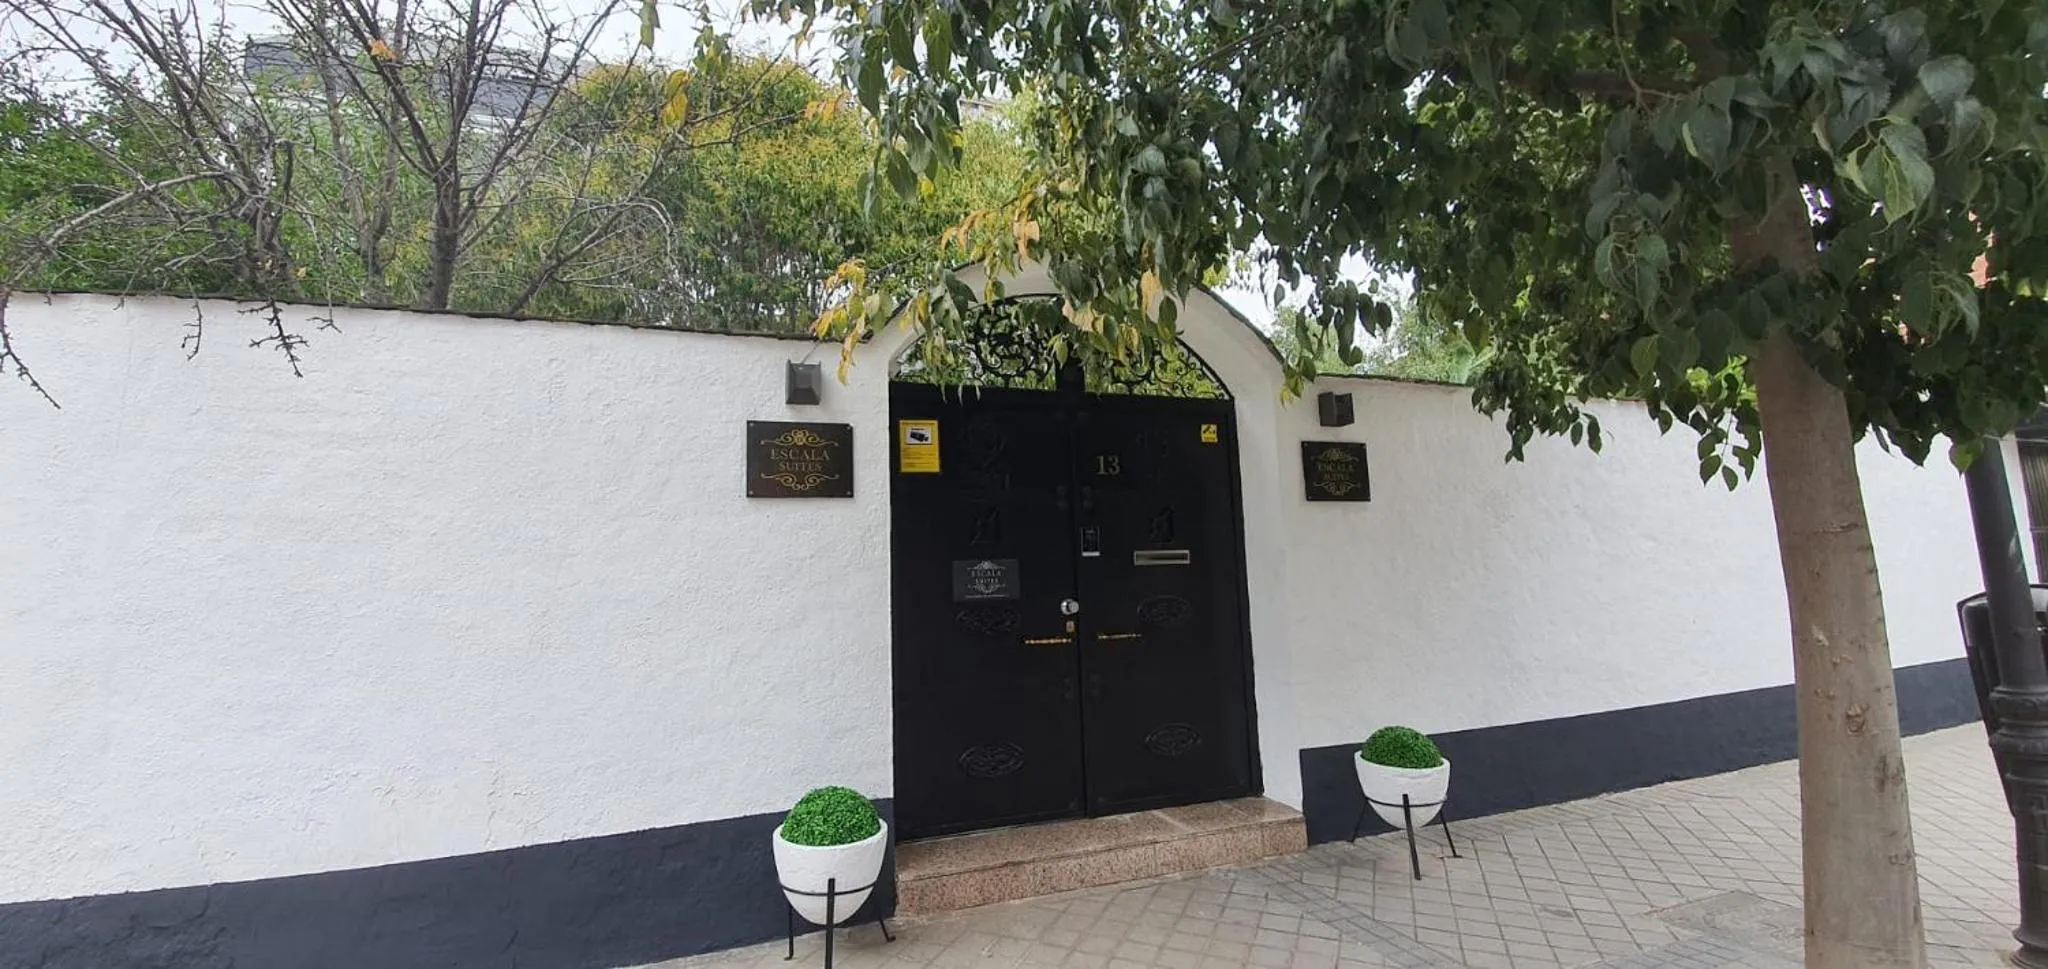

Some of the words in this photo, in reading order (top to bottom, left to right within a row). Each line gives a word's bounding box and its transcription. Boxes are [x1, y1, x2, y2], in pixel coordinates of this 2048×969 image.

[770, 448, 830, 461] ESCALA
[779, 462, 822, 472] SUITES
[1096, 455, 1121, 475] 13
